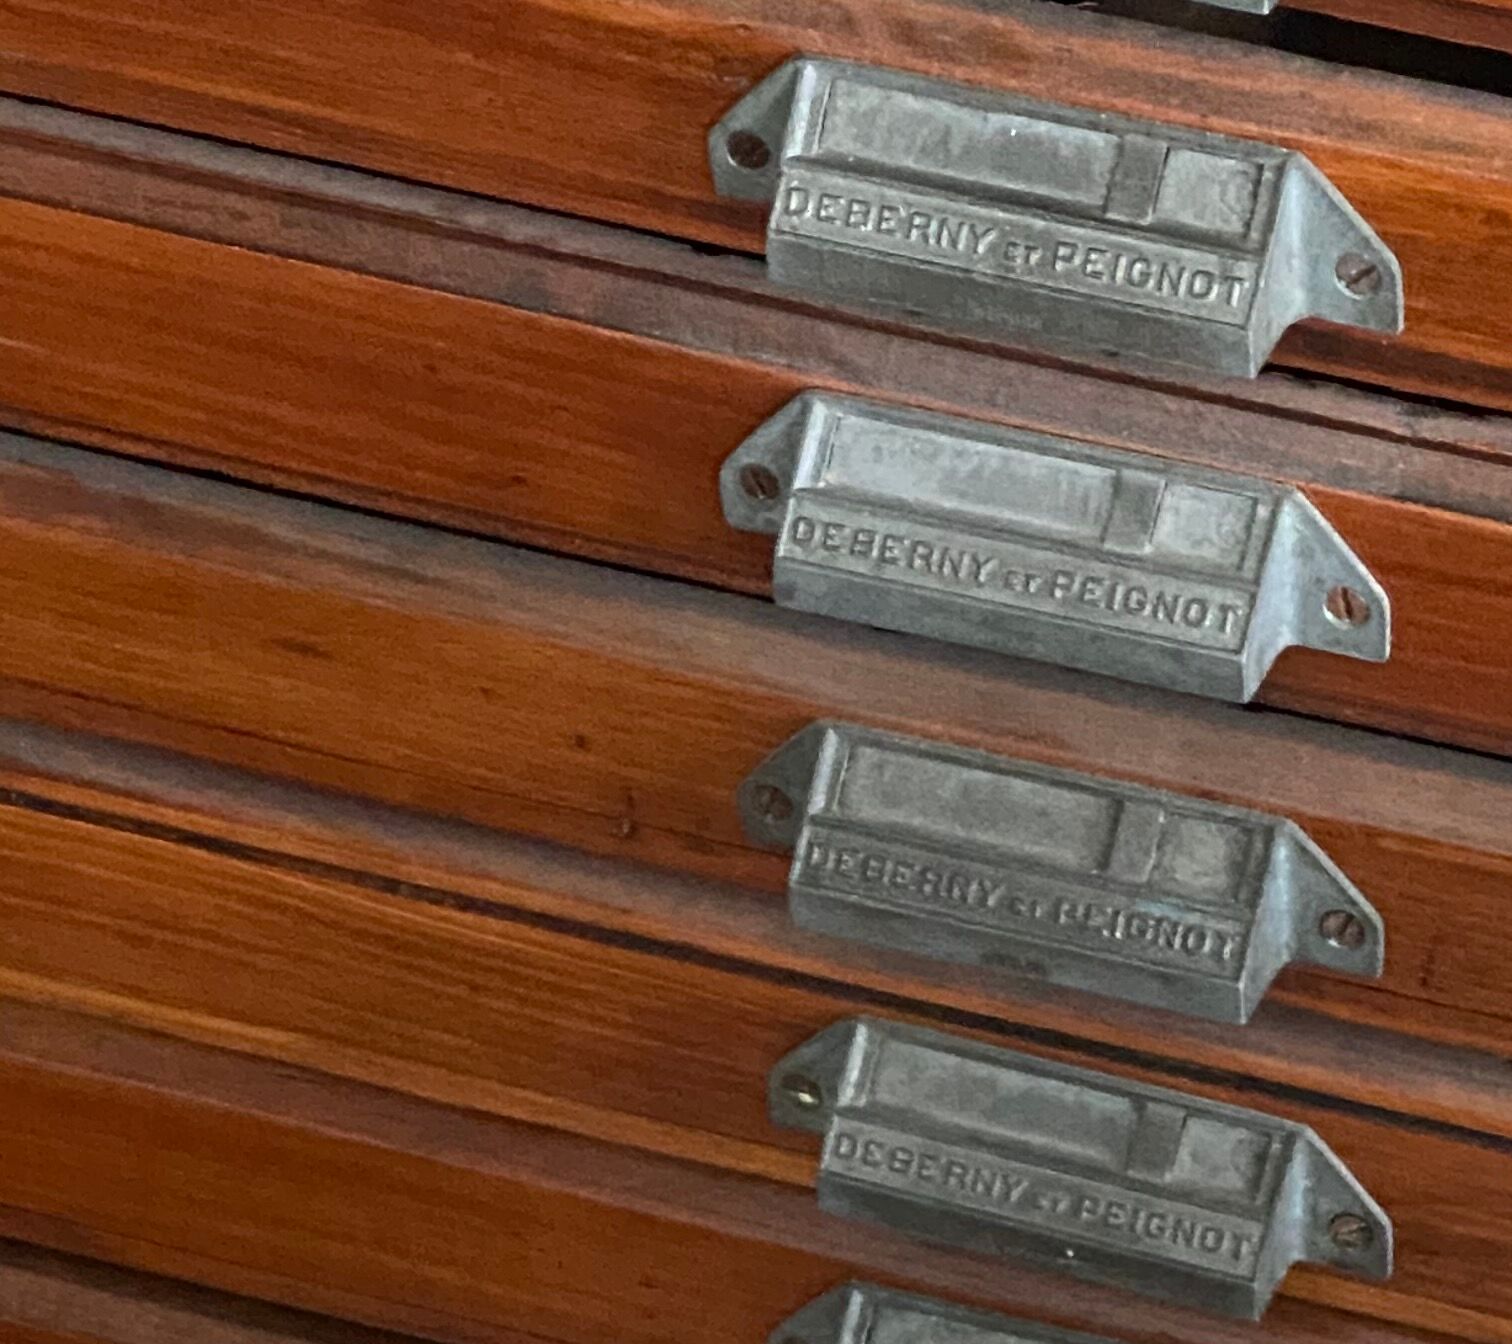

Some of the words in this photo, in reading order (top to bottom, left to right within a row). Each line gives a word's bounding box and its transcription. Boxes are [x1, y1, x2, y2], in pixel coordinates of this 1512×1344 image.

[783, 186, 995, 257] DEBERNY
[1052, 239, 1247, 307] PEIGNOT
[790, 516, 997, 584] DEBERNY
[1050, 568, 1243, 634] PEIGNOT
[833, 1132, 1029, 1203] DEBERNY
[1081, 1197, 1257, 1262] PEIGNOT
